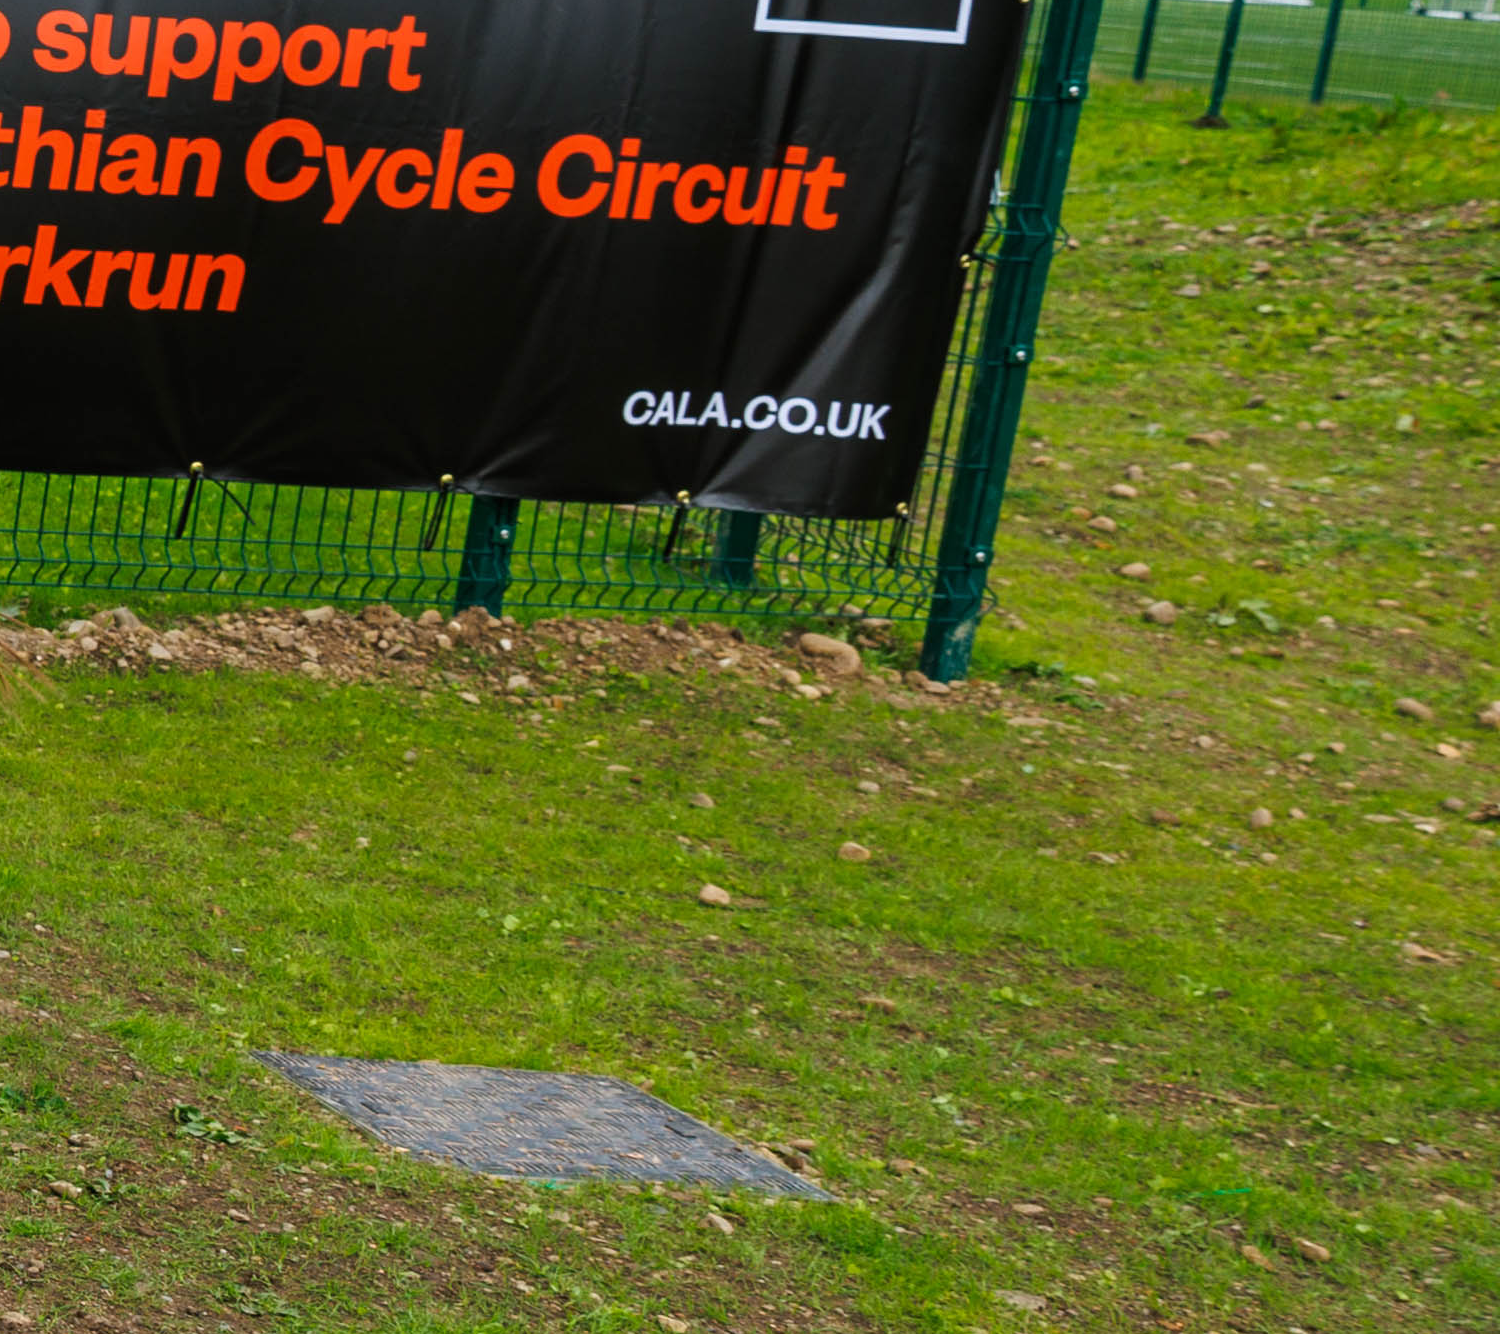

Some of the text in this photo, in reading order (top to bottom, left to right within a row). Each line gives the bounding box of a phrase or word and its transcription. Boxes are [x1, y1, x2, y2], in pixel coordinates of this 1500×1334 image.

[32, 9, 427, 102] support
[245, 118, 515, 224] Cycle
[537, 133, 846, 231] Circuit
[624, 391, 891, 440] CALA.CO.UK
